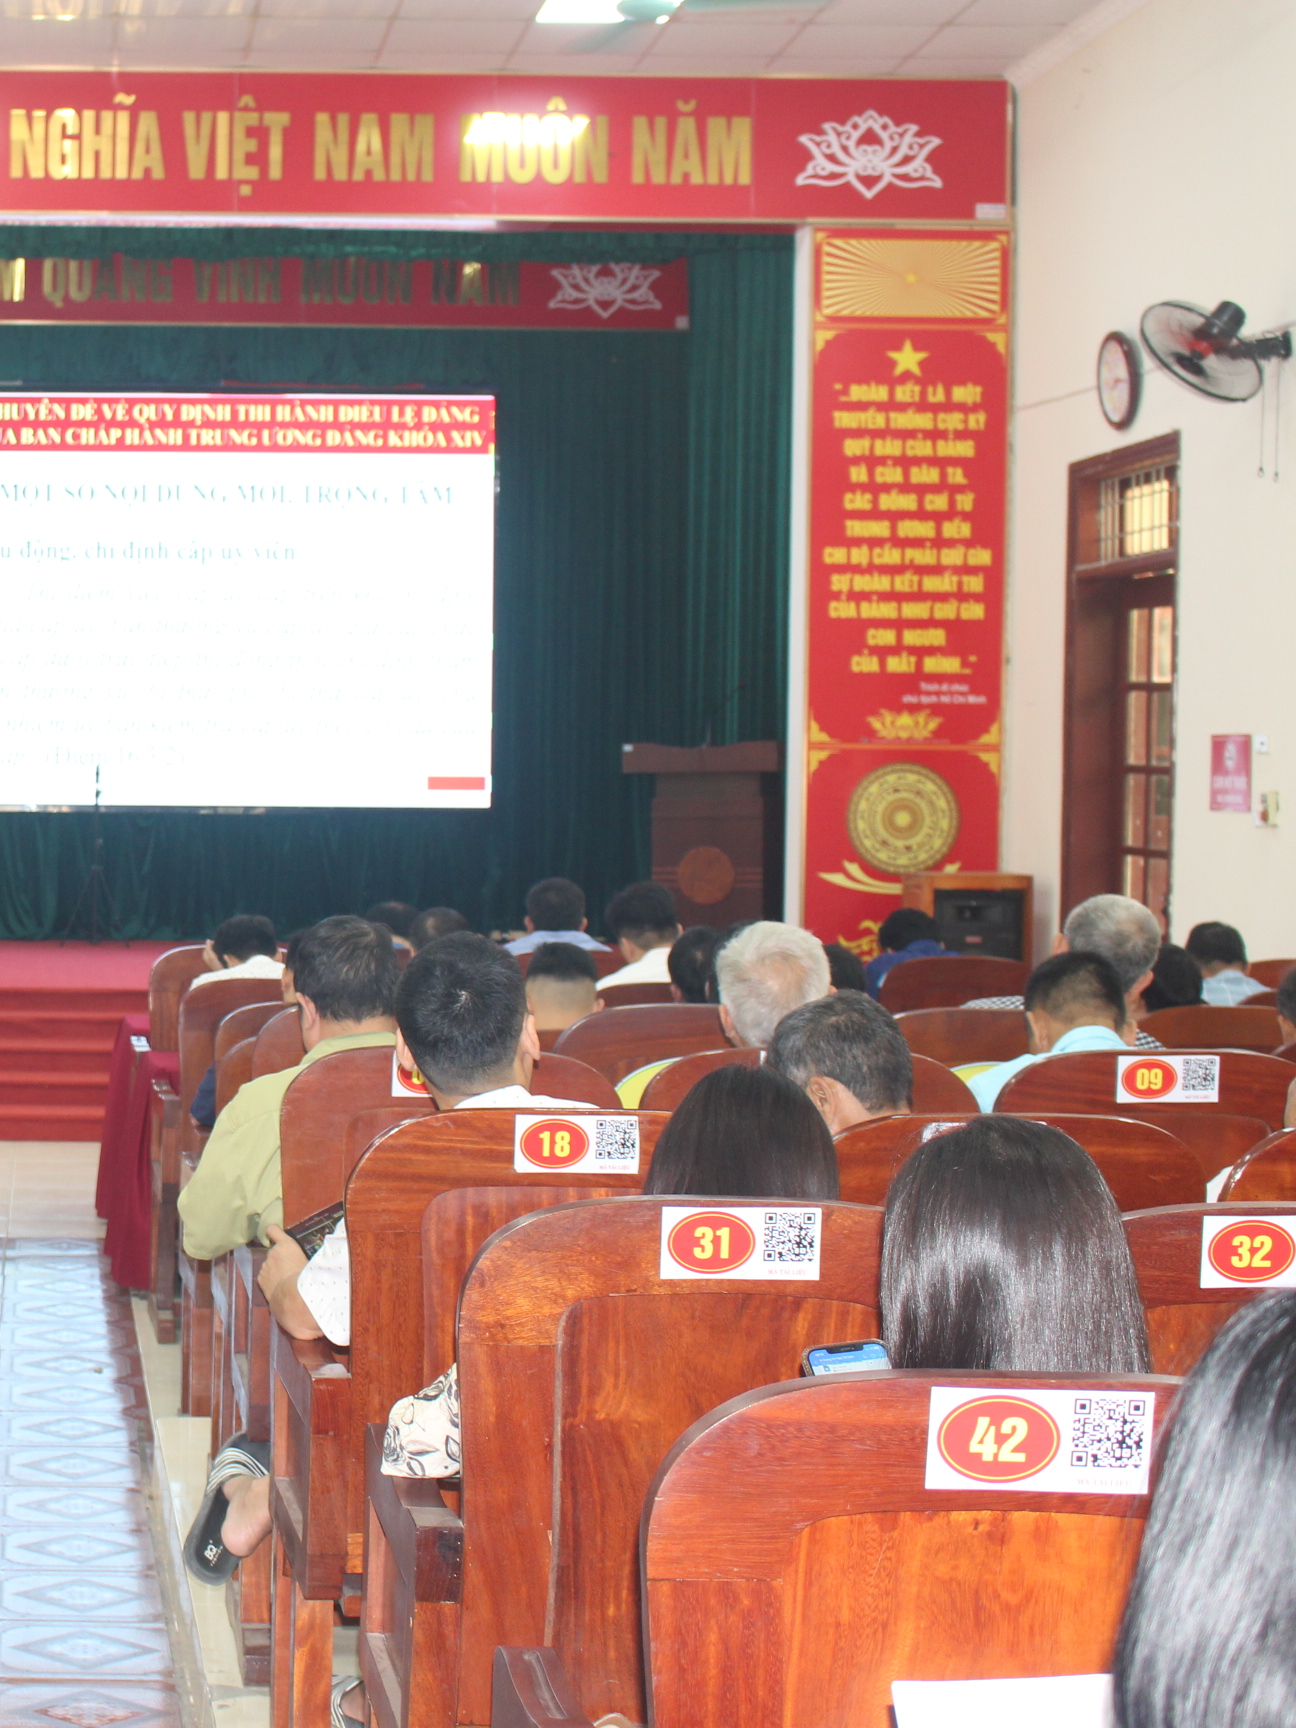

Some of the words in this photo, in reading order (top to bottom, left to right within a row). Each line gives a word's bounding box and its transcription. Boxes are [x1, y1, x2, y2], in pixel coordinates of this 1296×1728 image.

[10, 92, 166, 181] NGHĨA
[182, 94, 291, 197] VIỆT
[314, 111, 435, 182] NAM
[460, 97, 609, 186] MUÔN
[632, 99, 752, 186] NĂM
[42, 257, 173, 308] QUANG
[132, 403, 176, 424] QUY
[235, 404, 271, 422] THI
[275, 400, 334, 423] HÀNH
[391, 404, 418, 427] LỆ
[20, 427, 62, 445] BAN
[125, 424, 183, 446] HÀNH
[187, 428, 258, 446] TRUNG
[261, 426, 322, 447] ƯƠNG
[387, 426, 448, 448] KHÓA
[450, 430, 488, 448] XIV
[1136, 1068, 1163, 1090] 09
[539, 1131, 571, 1158] 18
[693, 1226, 730, 1259] 31
[1230, 1235, 1273, 1268] 32
[969, 1416, 1028, 1463] 42
